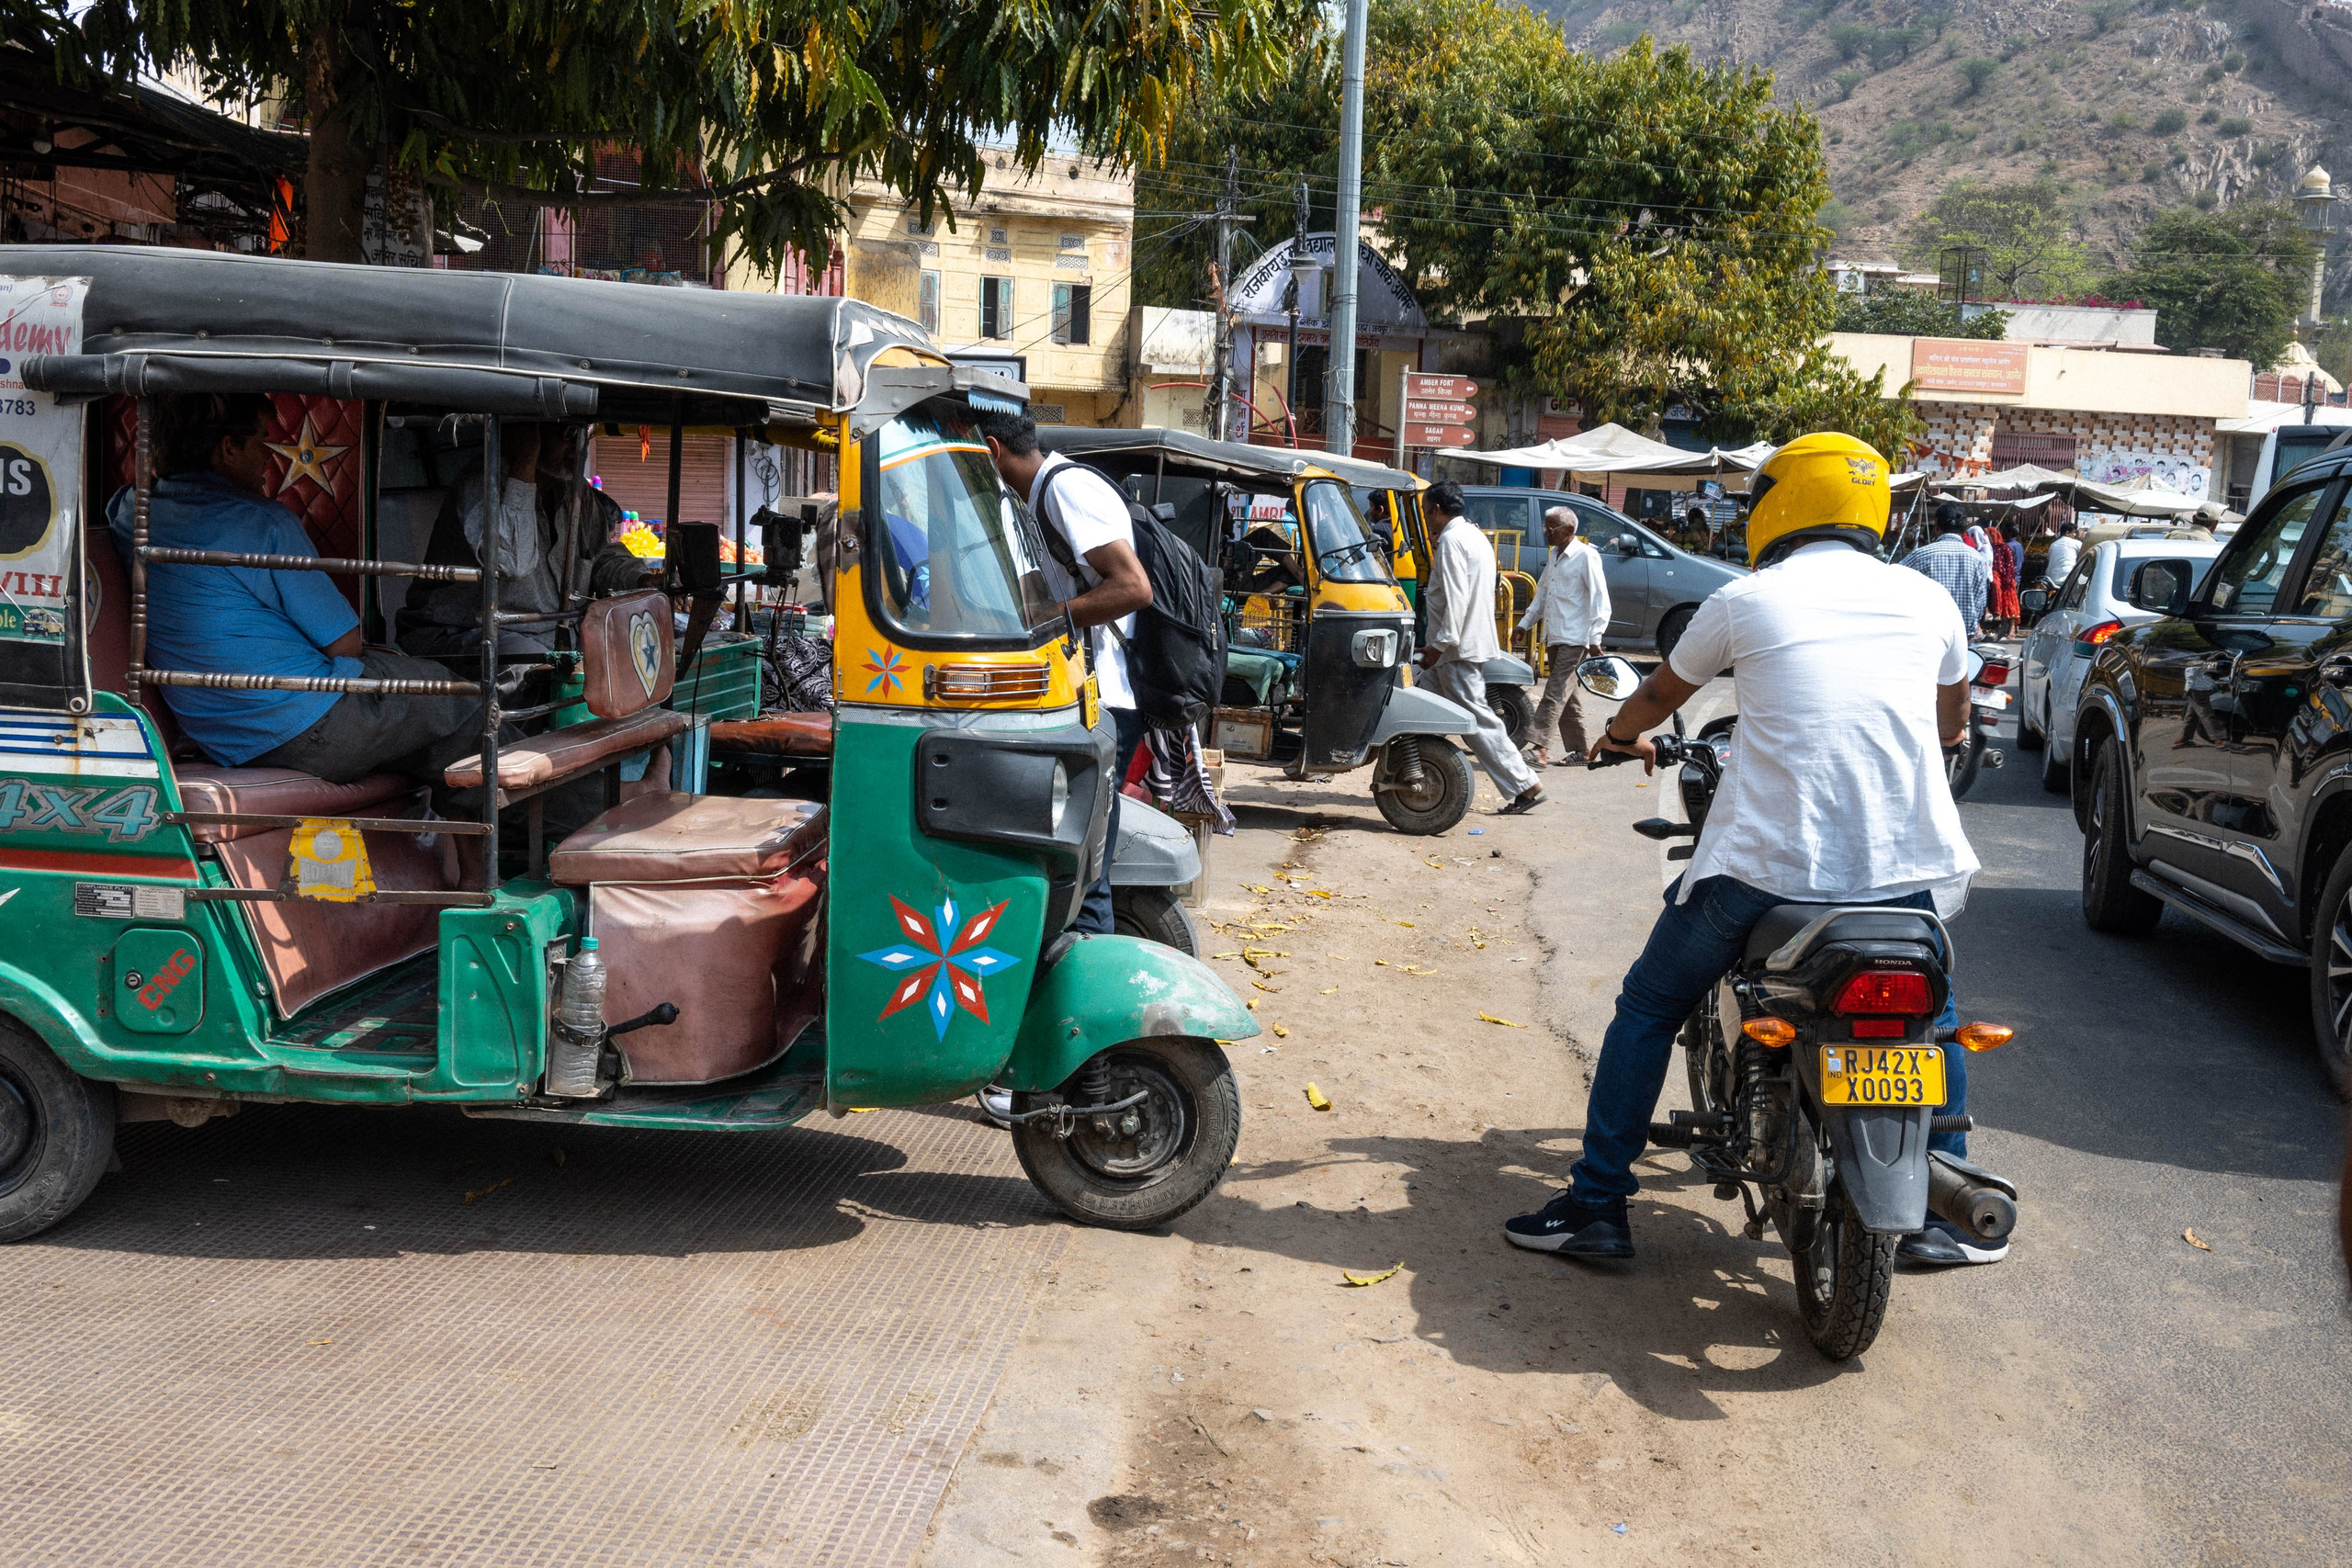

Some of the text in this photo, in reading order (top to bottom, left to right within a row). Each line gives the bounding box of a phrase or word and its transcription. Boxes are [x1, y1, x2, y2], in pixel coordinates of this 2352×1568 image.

[1242, 257, 1282, 299] राजकीय
[1425, 426, 1443, 434] SAGAR
[138, 948, 196, 1010] CNG
[1827, 1071, 1843, 1079] IND
[1844, 1049, 1921, 1076] RJ42X
[1846, 1076, 1924, 1103] X0093
